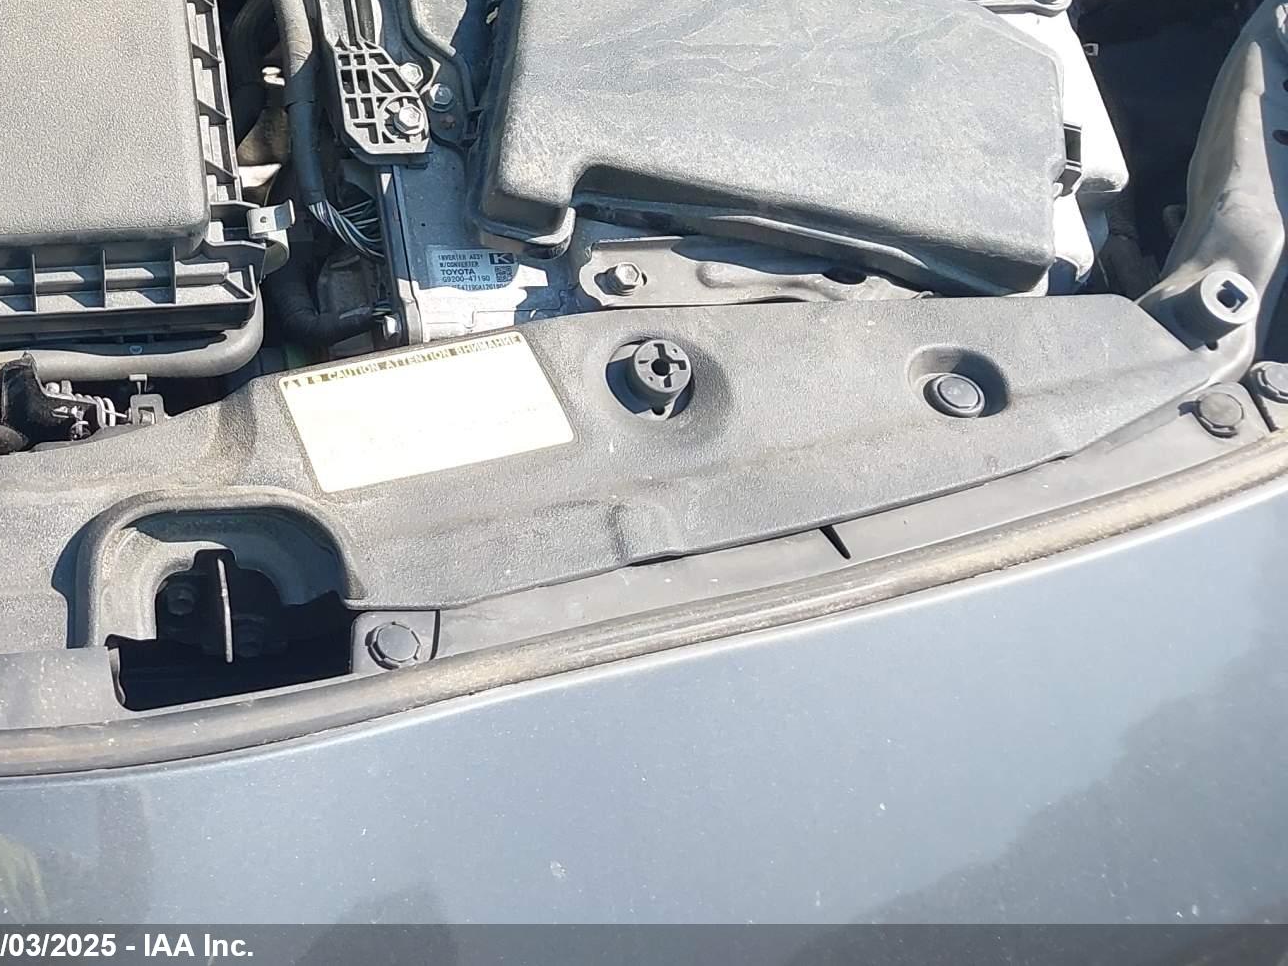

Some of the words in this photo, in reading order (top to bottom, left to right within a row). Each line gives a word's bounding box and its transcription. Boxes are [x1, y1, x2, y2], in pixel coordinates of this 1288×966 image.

[440, 268, 476, 276] TOYOTA
[329, 363, 379, 379] CAUTION
[386, 348, 450, 370] ATTENTION
